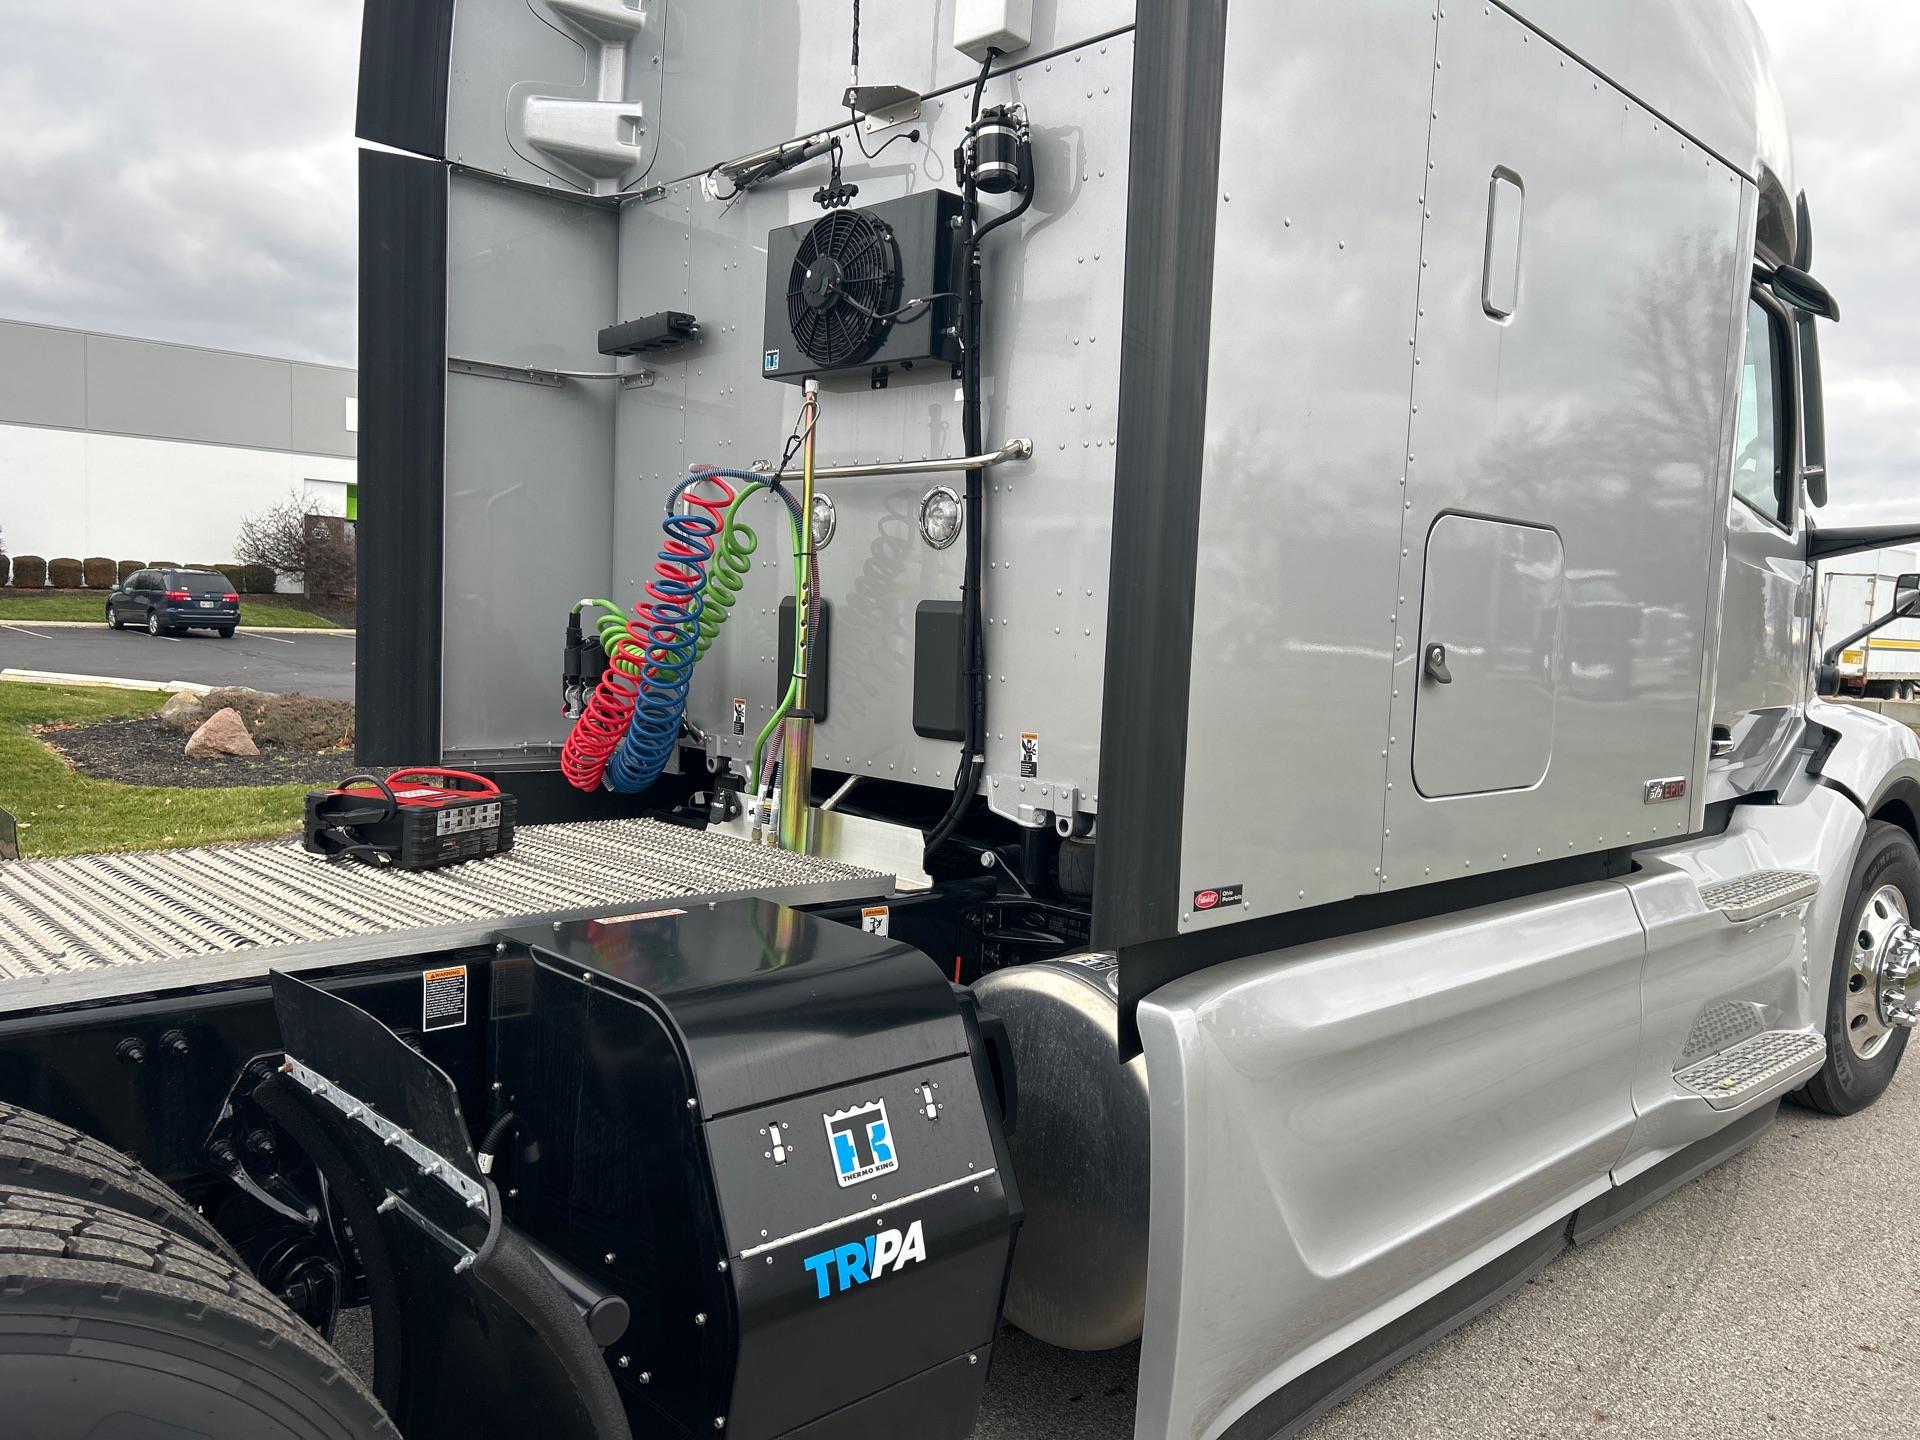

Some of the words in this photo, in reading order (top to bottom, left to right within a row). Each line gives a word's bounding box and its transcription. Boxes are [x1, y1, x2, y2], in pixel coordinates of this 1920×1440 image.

[434, 970, 460, 978] WARNING
[842, 1168, 874, 1182] THERMO
[875, 1161, 895, 1172] KING
